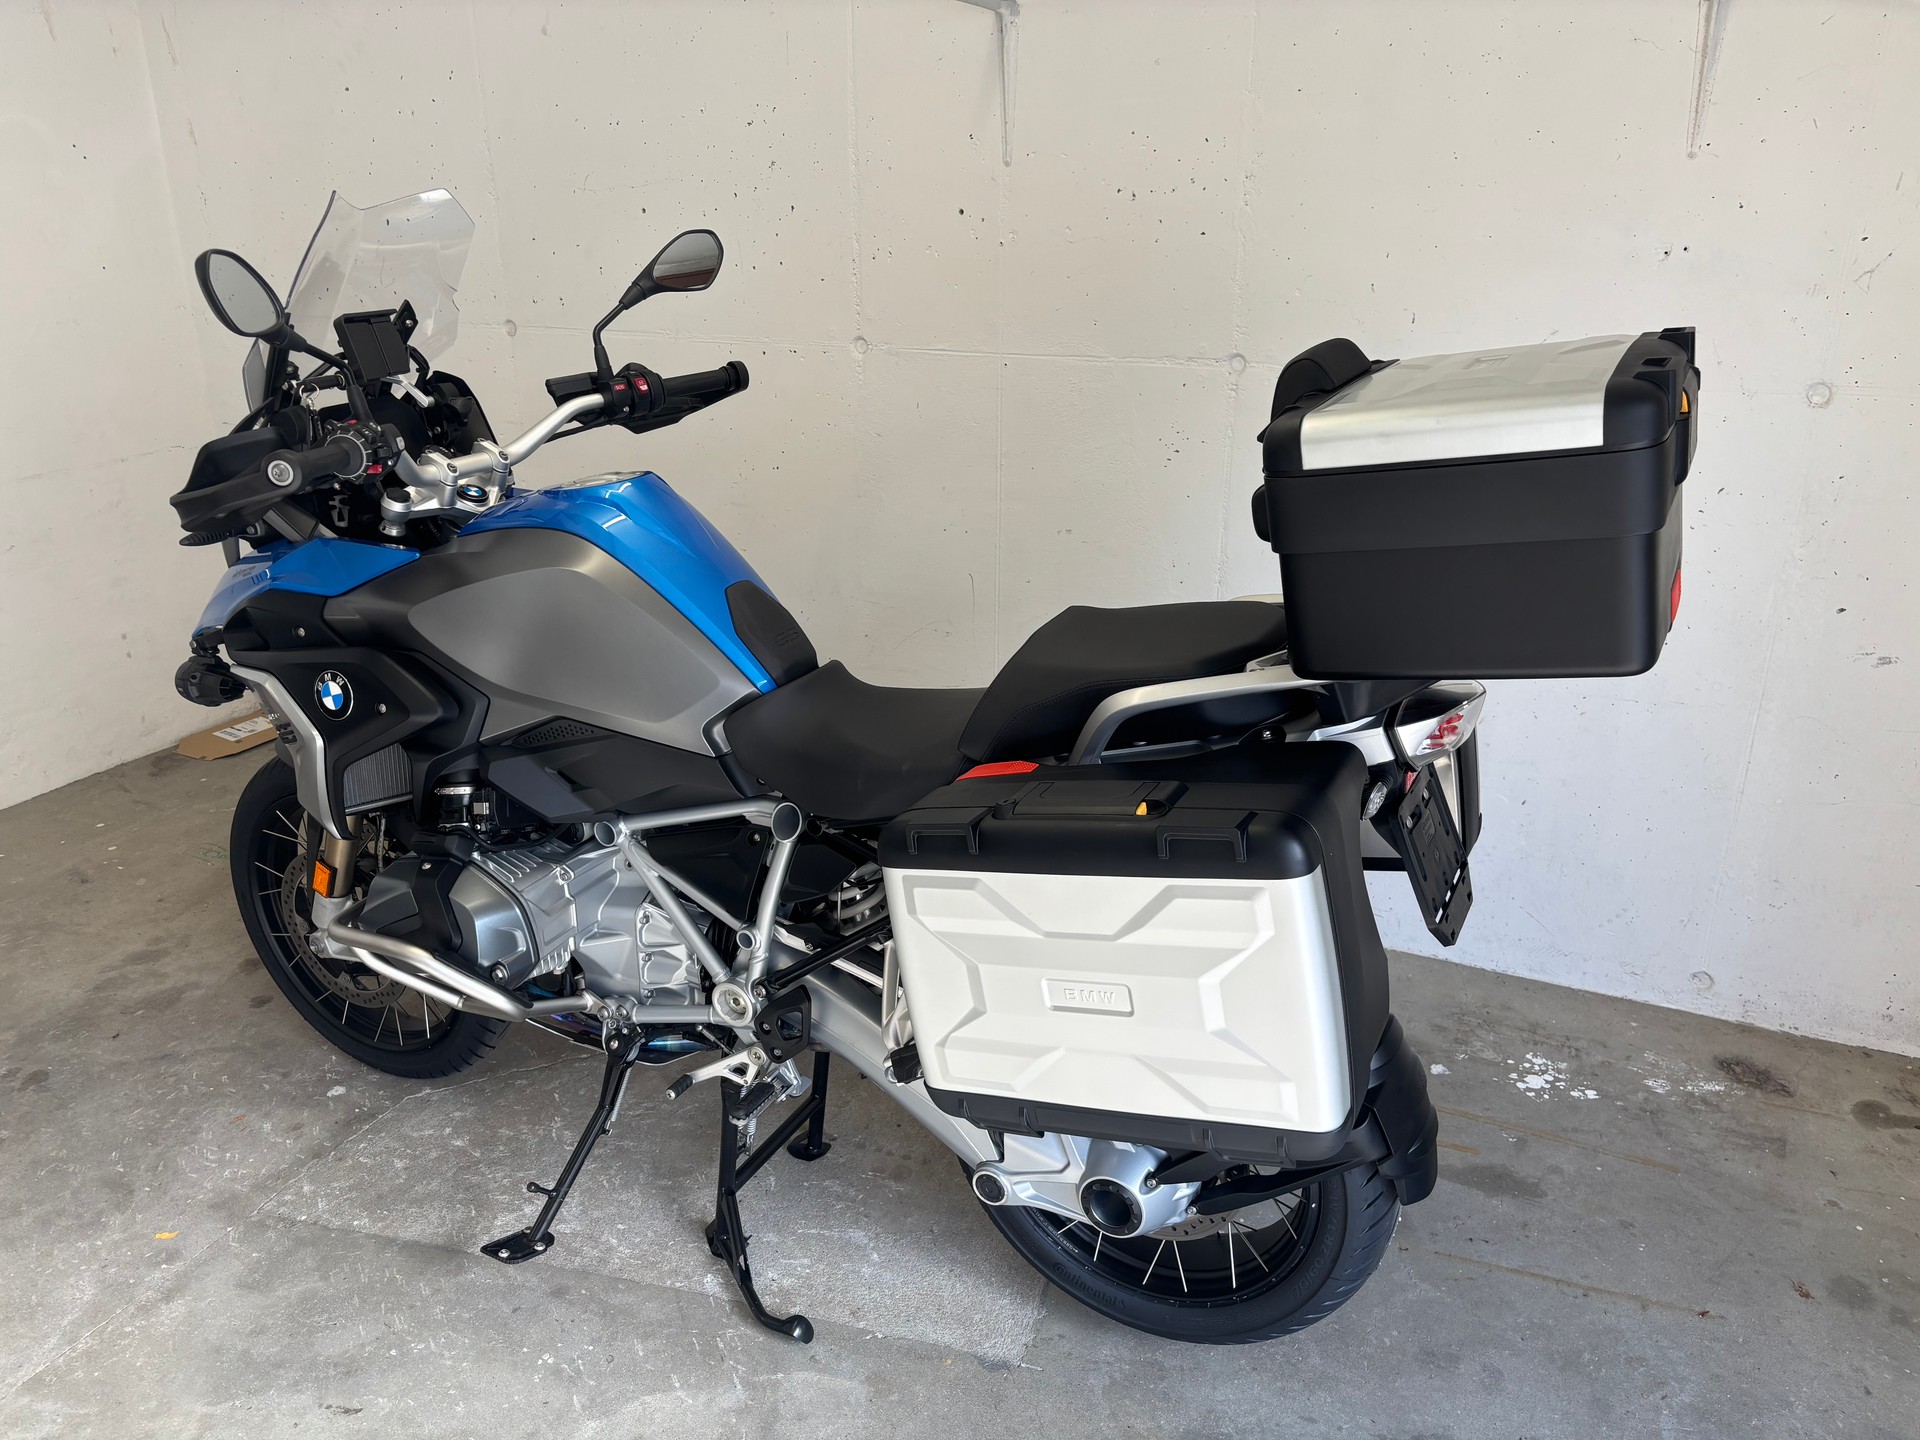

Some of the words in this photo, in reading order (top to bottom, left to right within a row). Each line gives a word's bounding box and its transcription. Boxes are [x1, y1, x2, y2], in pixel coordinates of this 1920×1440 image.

[317, 672, 345, 691] BMW
[1063, 988, 1115, 1004] BMW
[1051, 1262, 1117, 1306] Continental
